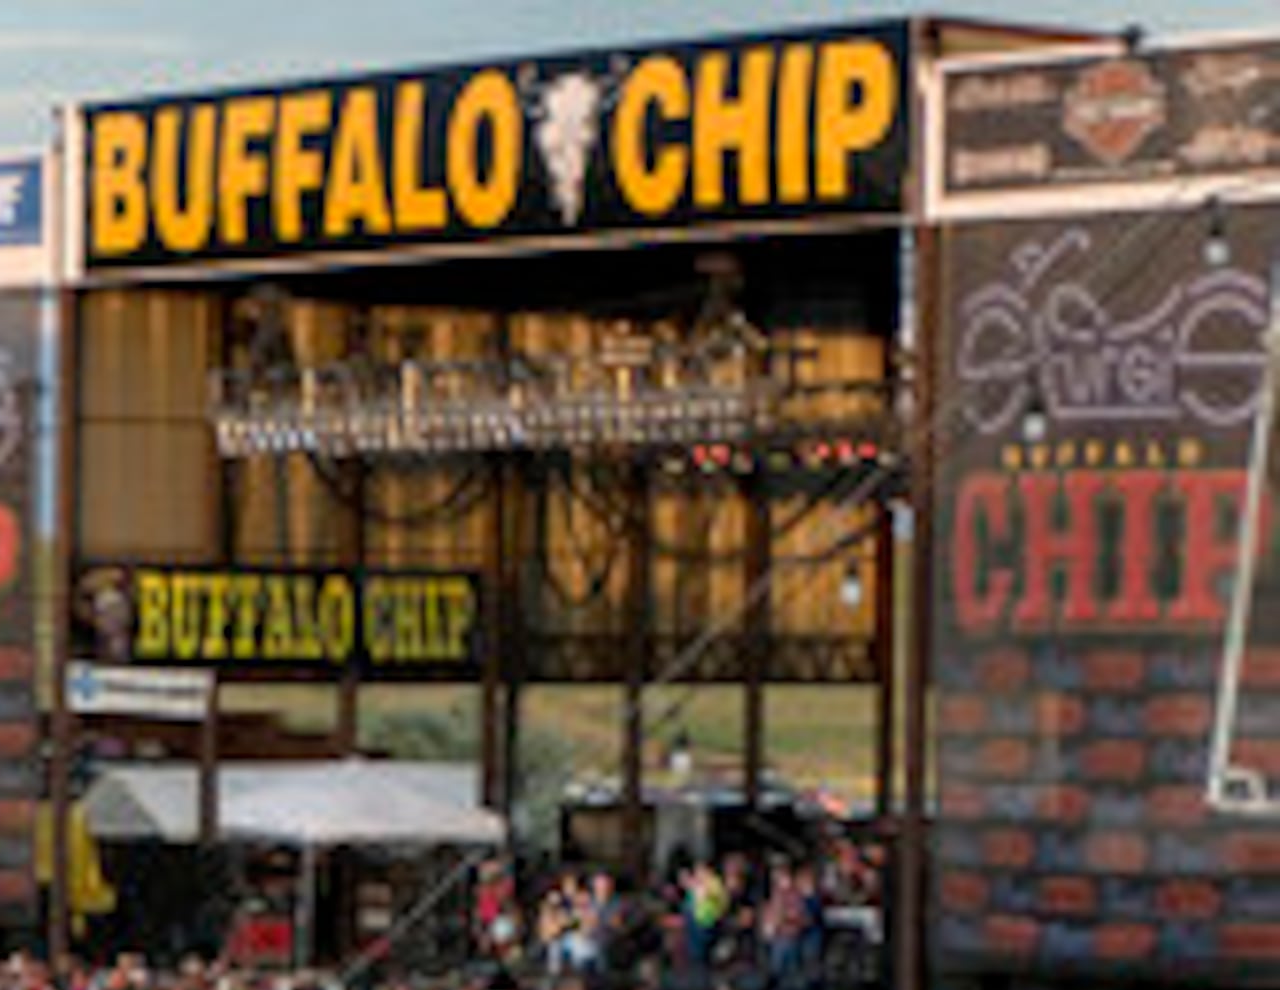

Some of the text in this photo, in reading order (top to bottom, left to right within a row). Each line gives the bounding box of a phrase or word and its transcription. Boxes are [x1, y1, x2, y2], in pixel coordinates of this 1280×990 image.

[92, 39, 897, 256] BUFFALO CHIP
[136, 570, 477, 661] BUFFALO CHIP
[952, 468, 1276, 635] CHIP
